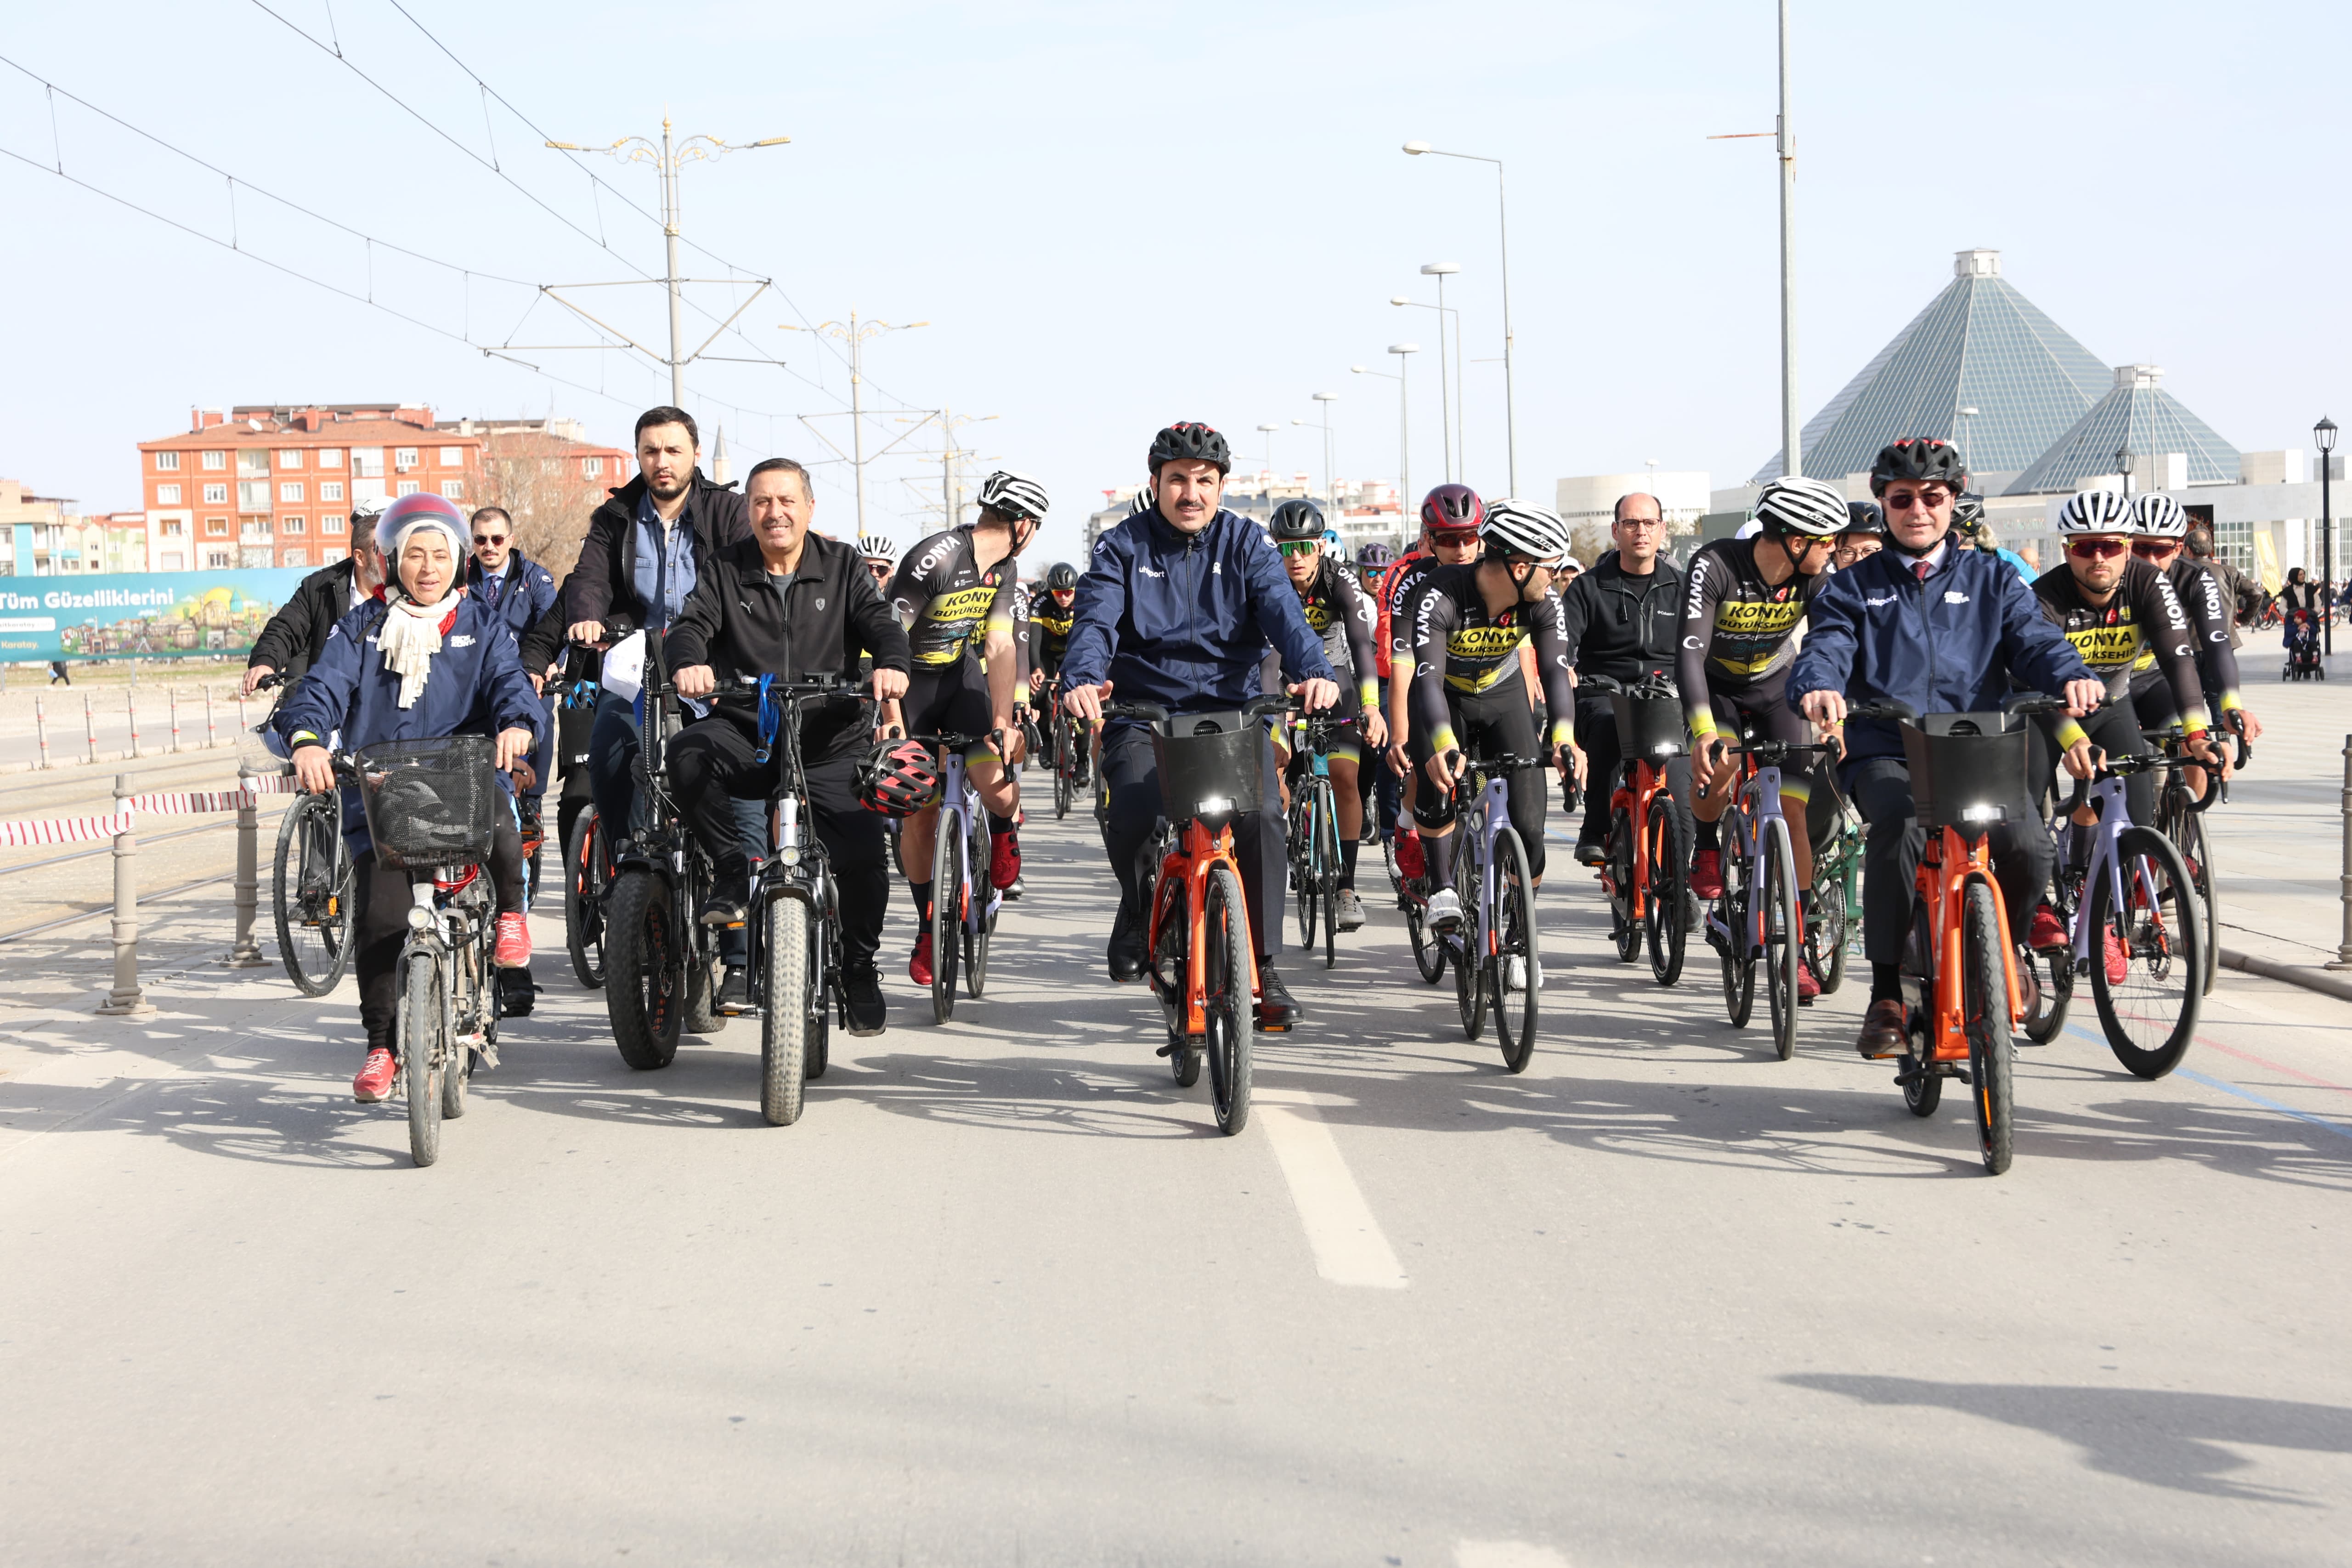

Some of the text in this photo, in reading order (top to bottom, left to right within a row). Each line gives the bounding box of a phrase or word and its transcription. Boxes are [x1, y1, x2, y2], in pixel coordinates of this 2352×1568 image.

[1806, 513, 1830, 526] LAZER
[911, 536, 961, 582] KONYA
[1531, 536, 1553, 550] LAZER
[44, 588, 174, 609] Güzelliklerini
[1392, 571, 1427, 616] KONYA
[1688, 557, 1710, 619] KONYA
[2155, 571, 2187, 630] KONYA
[2200, 572, 2222, 620] KONYA
[1416, 588, 1443, 647] KONYA
[1729, 606, 1794, 619] KONYA
[1453, 631, 1518, 644] KONYA
[2068, 632, 2132, 649] KONYA
